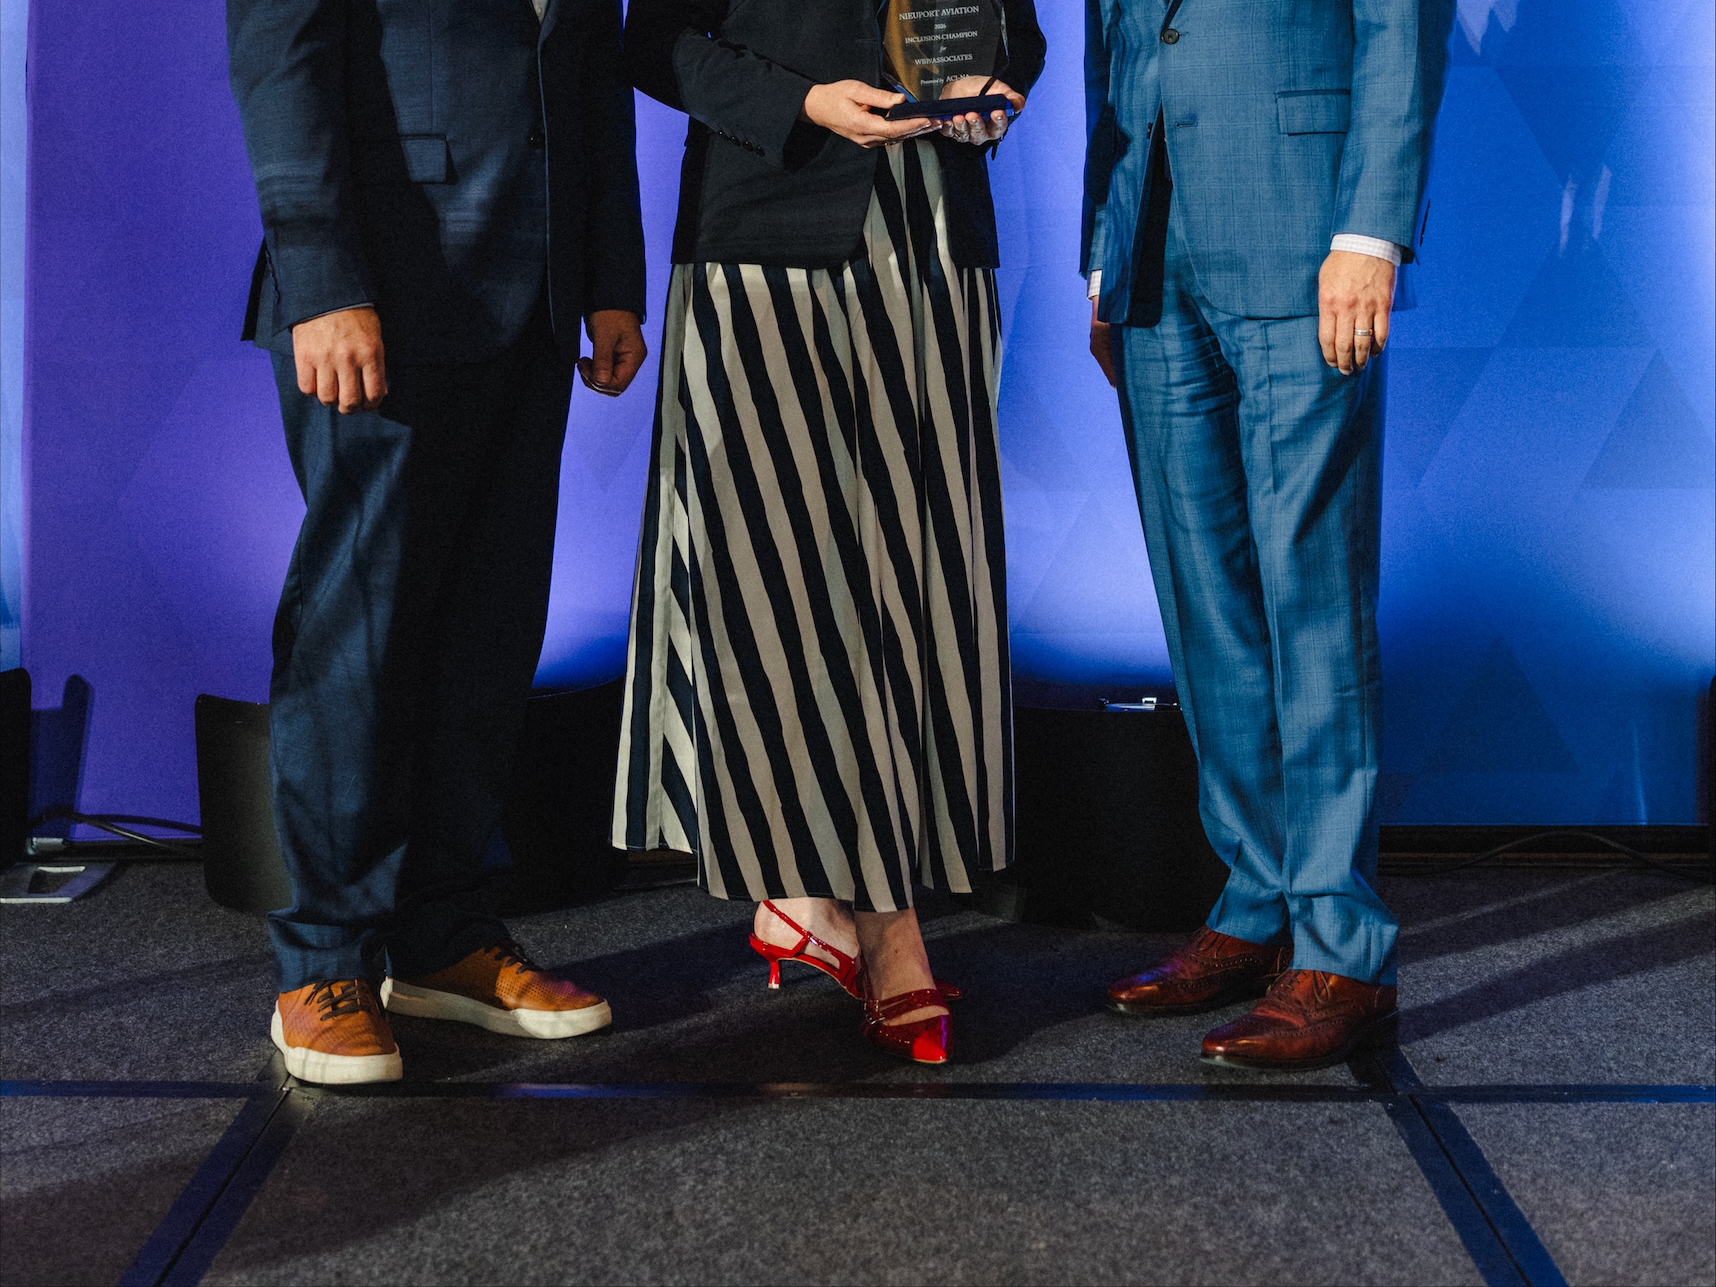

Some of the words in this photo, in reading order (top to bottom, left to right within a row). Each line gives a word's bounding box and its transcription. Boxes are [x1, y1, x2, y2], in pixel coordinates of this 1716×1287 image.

[899, 9, 940, 20] NIEUPORT
[940, 5, 980, 17] AVIATION
[905, 34, 941, 44] INCLUSION
[941, 30, 978, 40] CHAMPION
